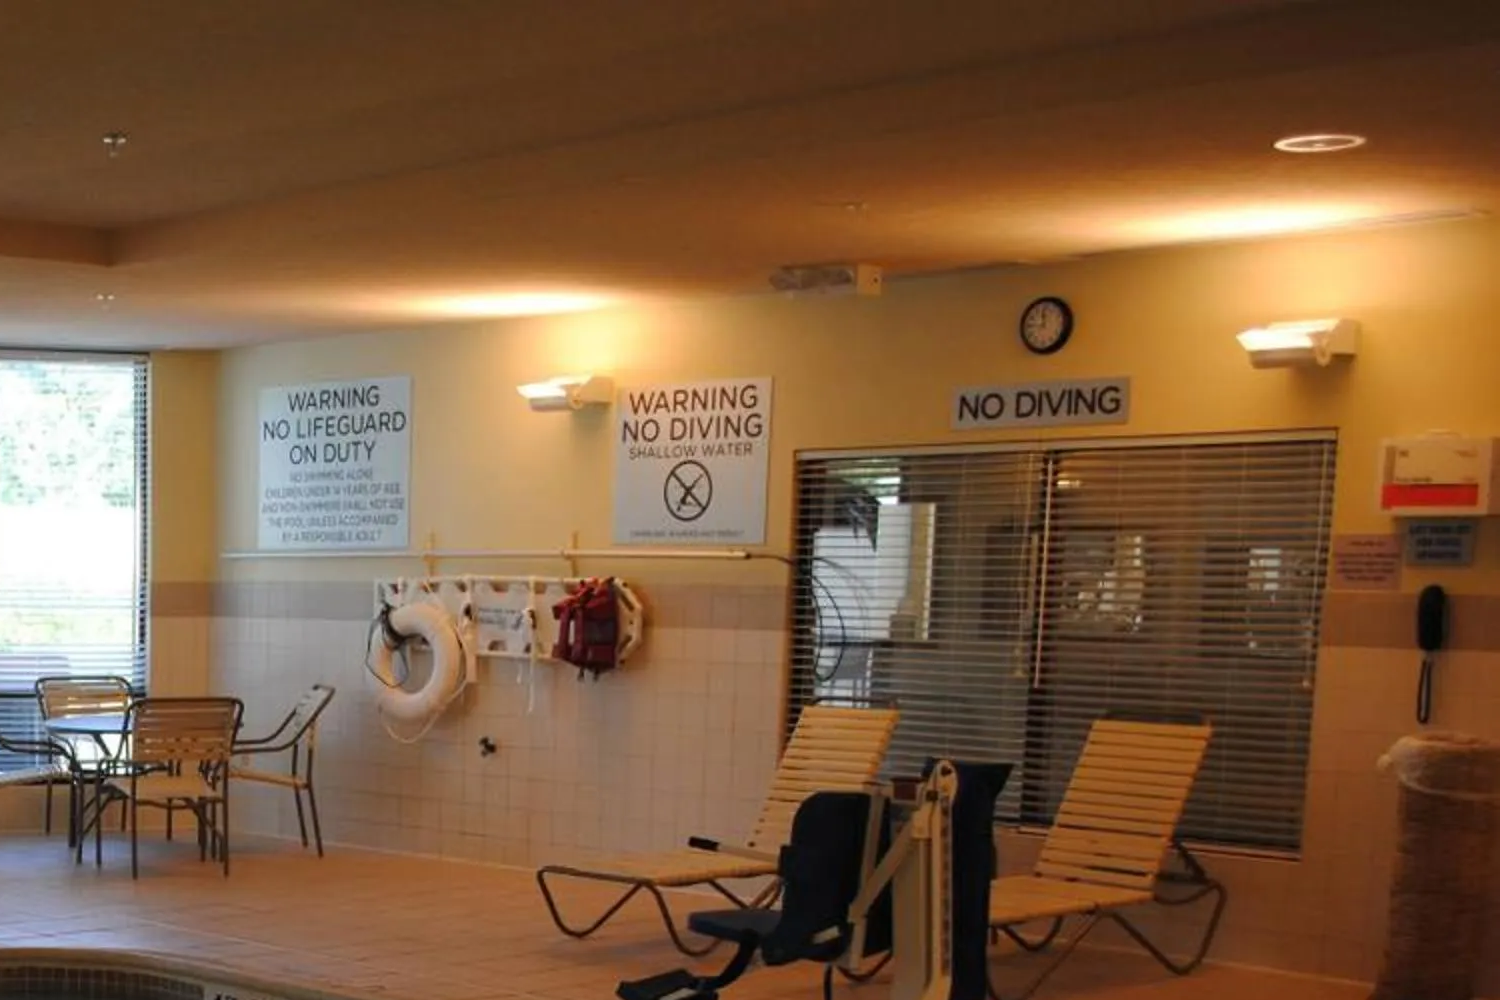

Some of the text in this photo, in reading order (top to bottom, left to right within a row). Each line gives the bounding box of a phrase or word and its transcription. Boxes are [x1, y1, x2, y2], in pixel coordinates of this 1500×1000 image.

[288, 385, 380, 412] WARNING
[629, 384, 758, 415] WARNING
[958, 385, 1121, 421] NO DIVING
[263, 411, 406, 441] NO LIFEGUARD
[622, 413, 762, 443] NO DIVING
[289, 441, 376, 465] ON DUTY
[629, 443, 752, 460] SHALLOW WATER
